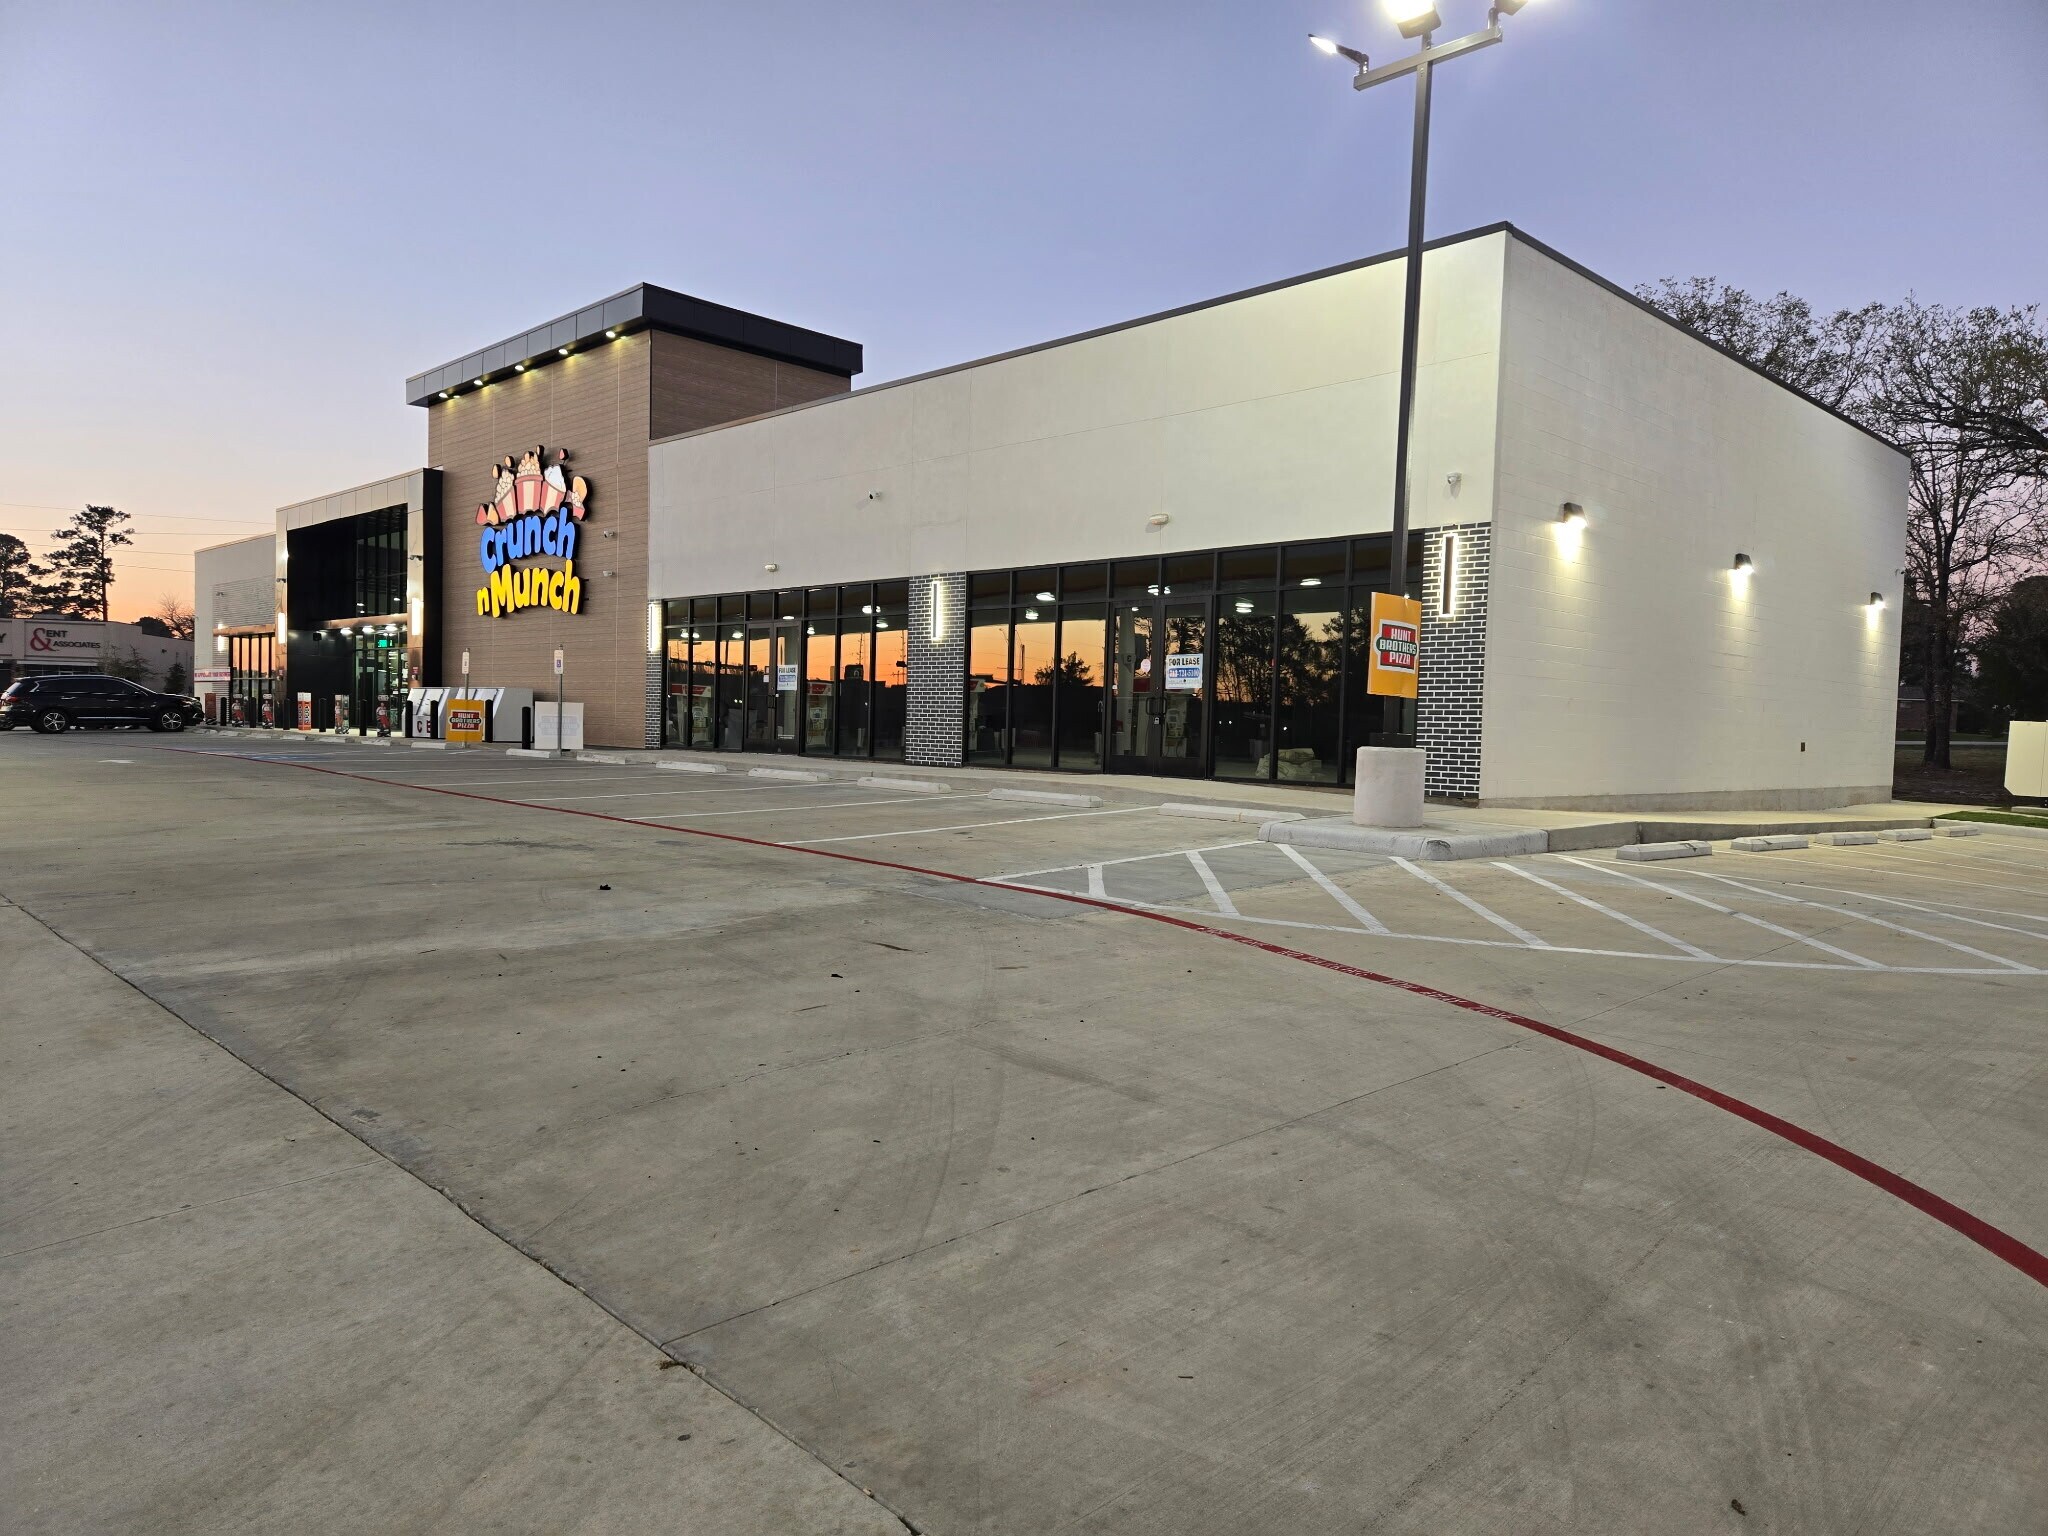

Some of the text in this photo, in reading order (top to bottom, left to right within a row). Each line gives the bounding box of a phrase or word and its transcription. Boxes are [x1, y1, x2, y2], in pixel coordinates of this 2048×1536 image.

[480, 507, 576, 573] Crunch
[490, 559, 581, 618] Munch
[46, 630, 68, 638] ENT
[1391, 628, 1411, 642] HUNT
[53, 641, 101, 649] ASSOCIATES
[1379, 639, 1416, 654] BROTHERS
[1168, 657, 1200, 666] FOR LEASE
[1389, 652, 1411, 665] PIZZA
